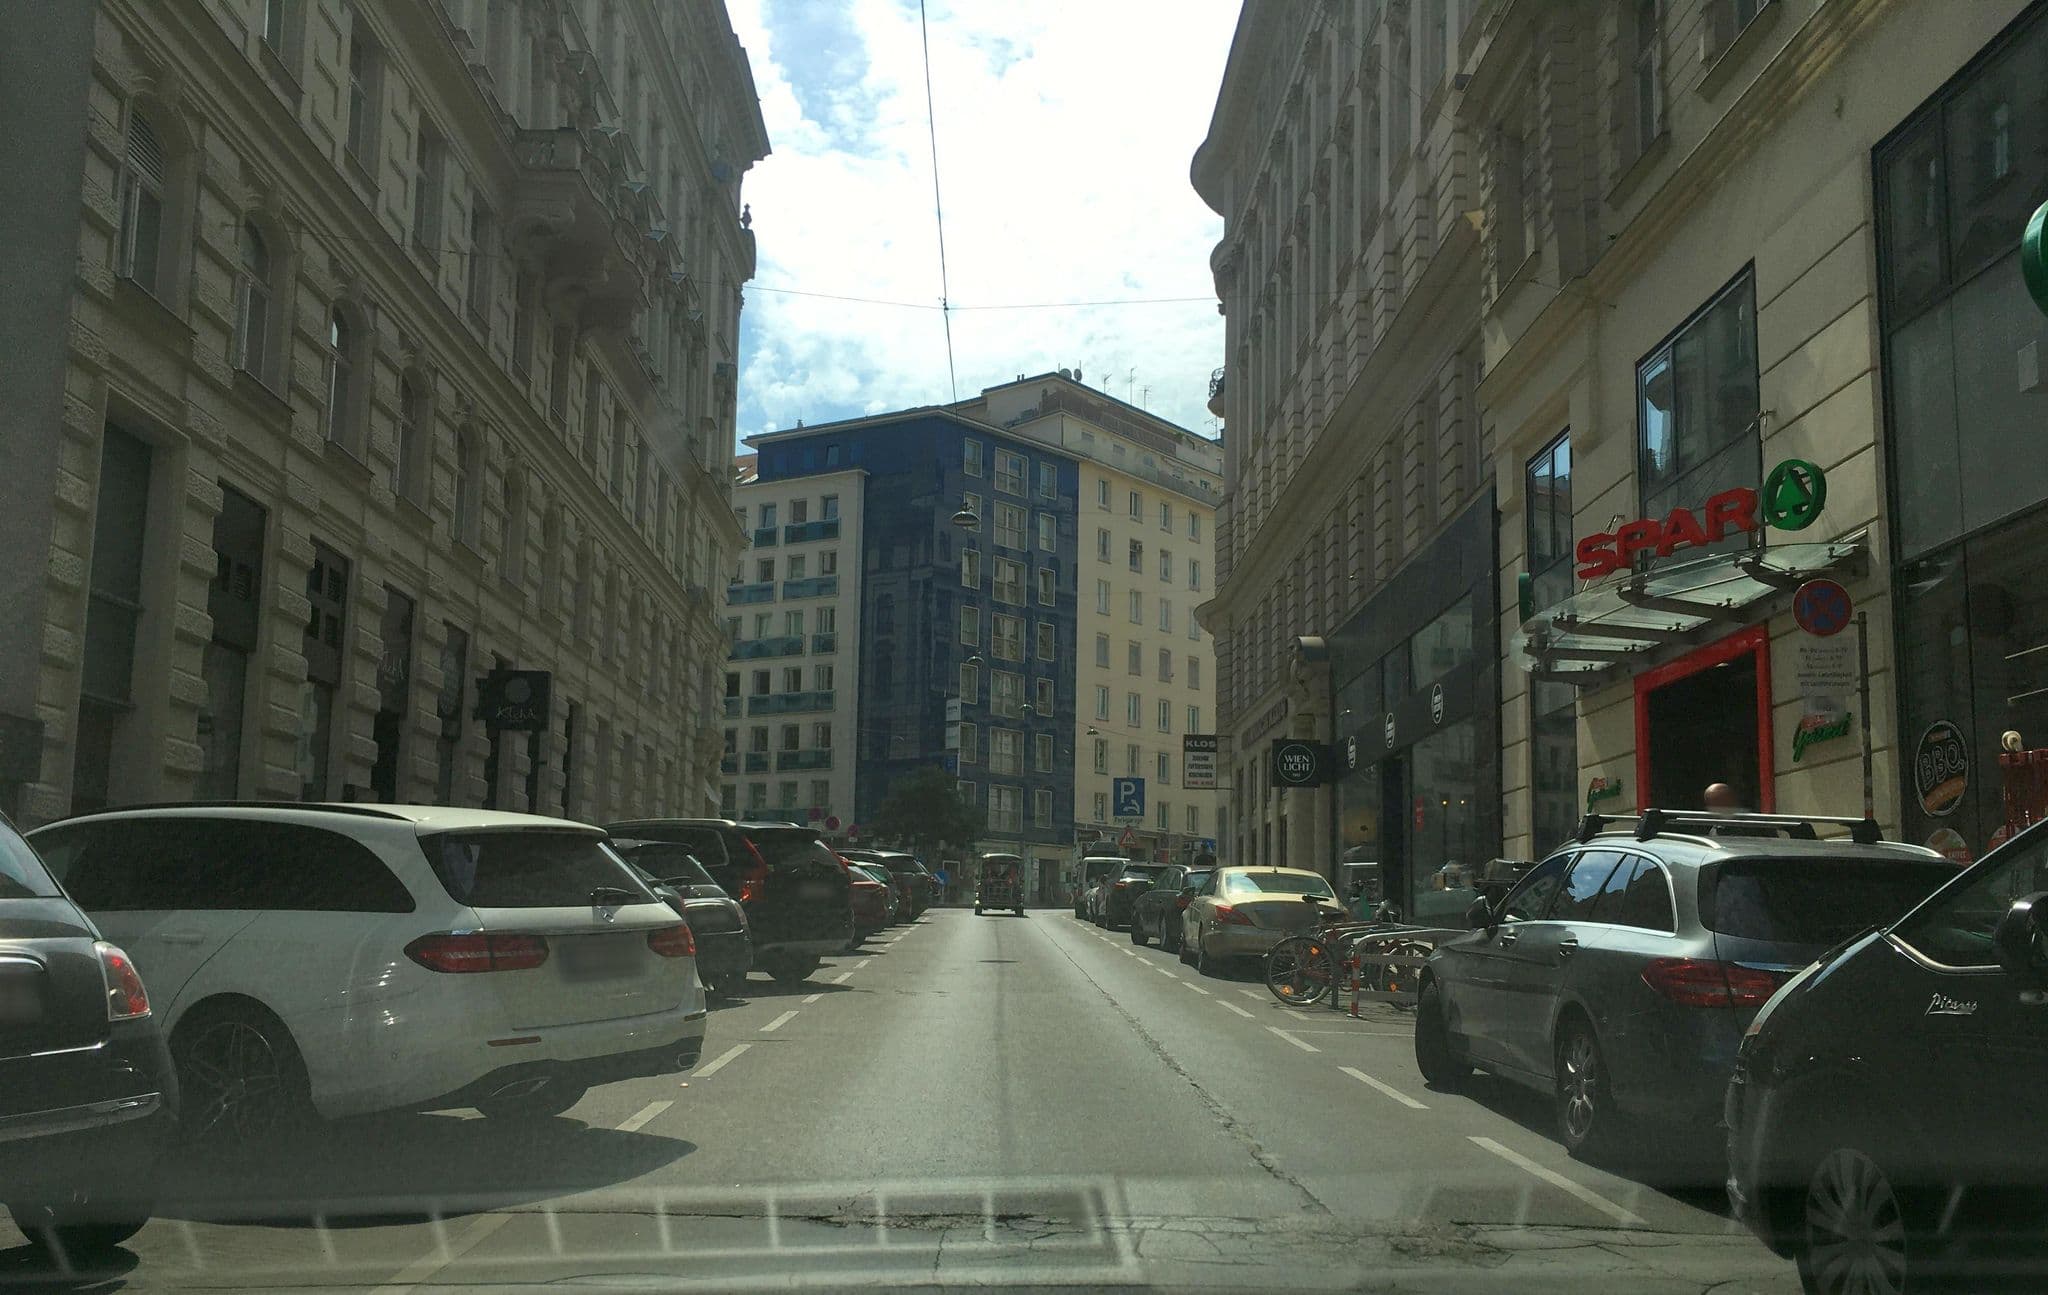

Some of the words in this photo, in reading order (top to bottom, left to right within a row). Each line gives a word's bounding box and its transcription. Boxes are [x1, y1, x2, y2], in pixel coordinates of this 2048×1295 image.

[1577, 487, 1759, 579] SPAR
[1186, 740, 1216, 748] KLOS
[1284, 754, 1310, 763] WIEN
[1283, 763, 1311, 771] LICHT
[1121, 782, 1135, 803] P
[1924, 993, 1977, 1016] Picasso
